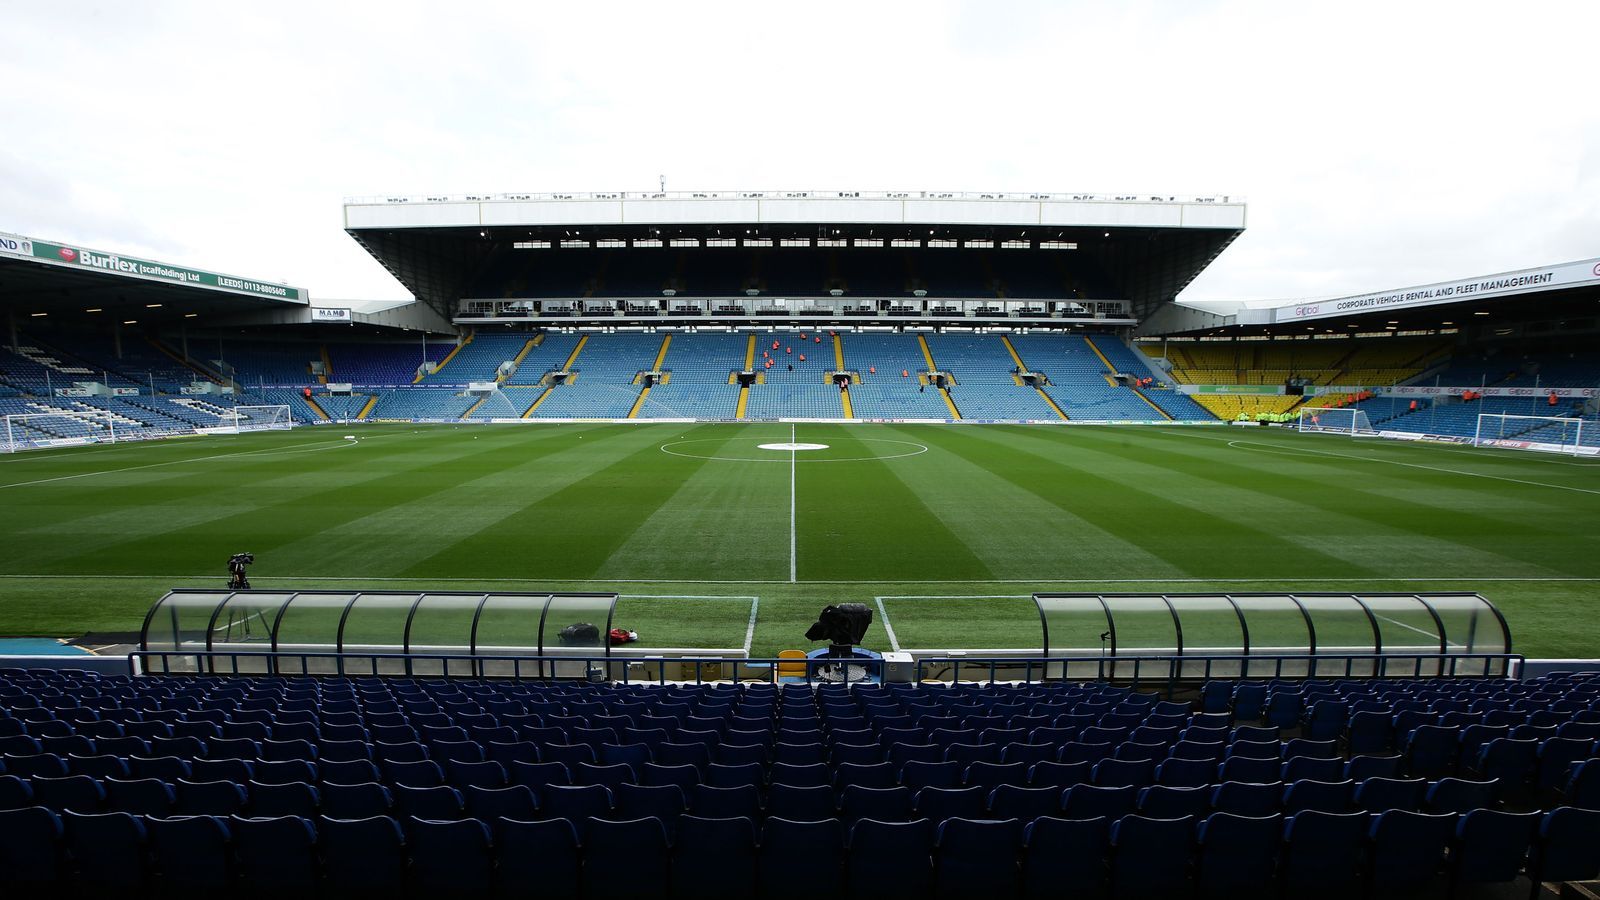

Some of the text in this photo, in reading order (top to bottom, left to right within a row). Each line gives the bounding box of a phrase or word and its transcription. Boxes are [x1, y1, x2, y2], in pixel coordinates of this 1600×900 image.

[79, 250, 138, 273] Burflex
[139, 264, 187, 281] (scaffolding)
[188, 273, 200, 282] Ltd
[1337, 273, 1553, 310] CORPORATE VEHICLE RENTAL AND FLEET MANAGEMENT
